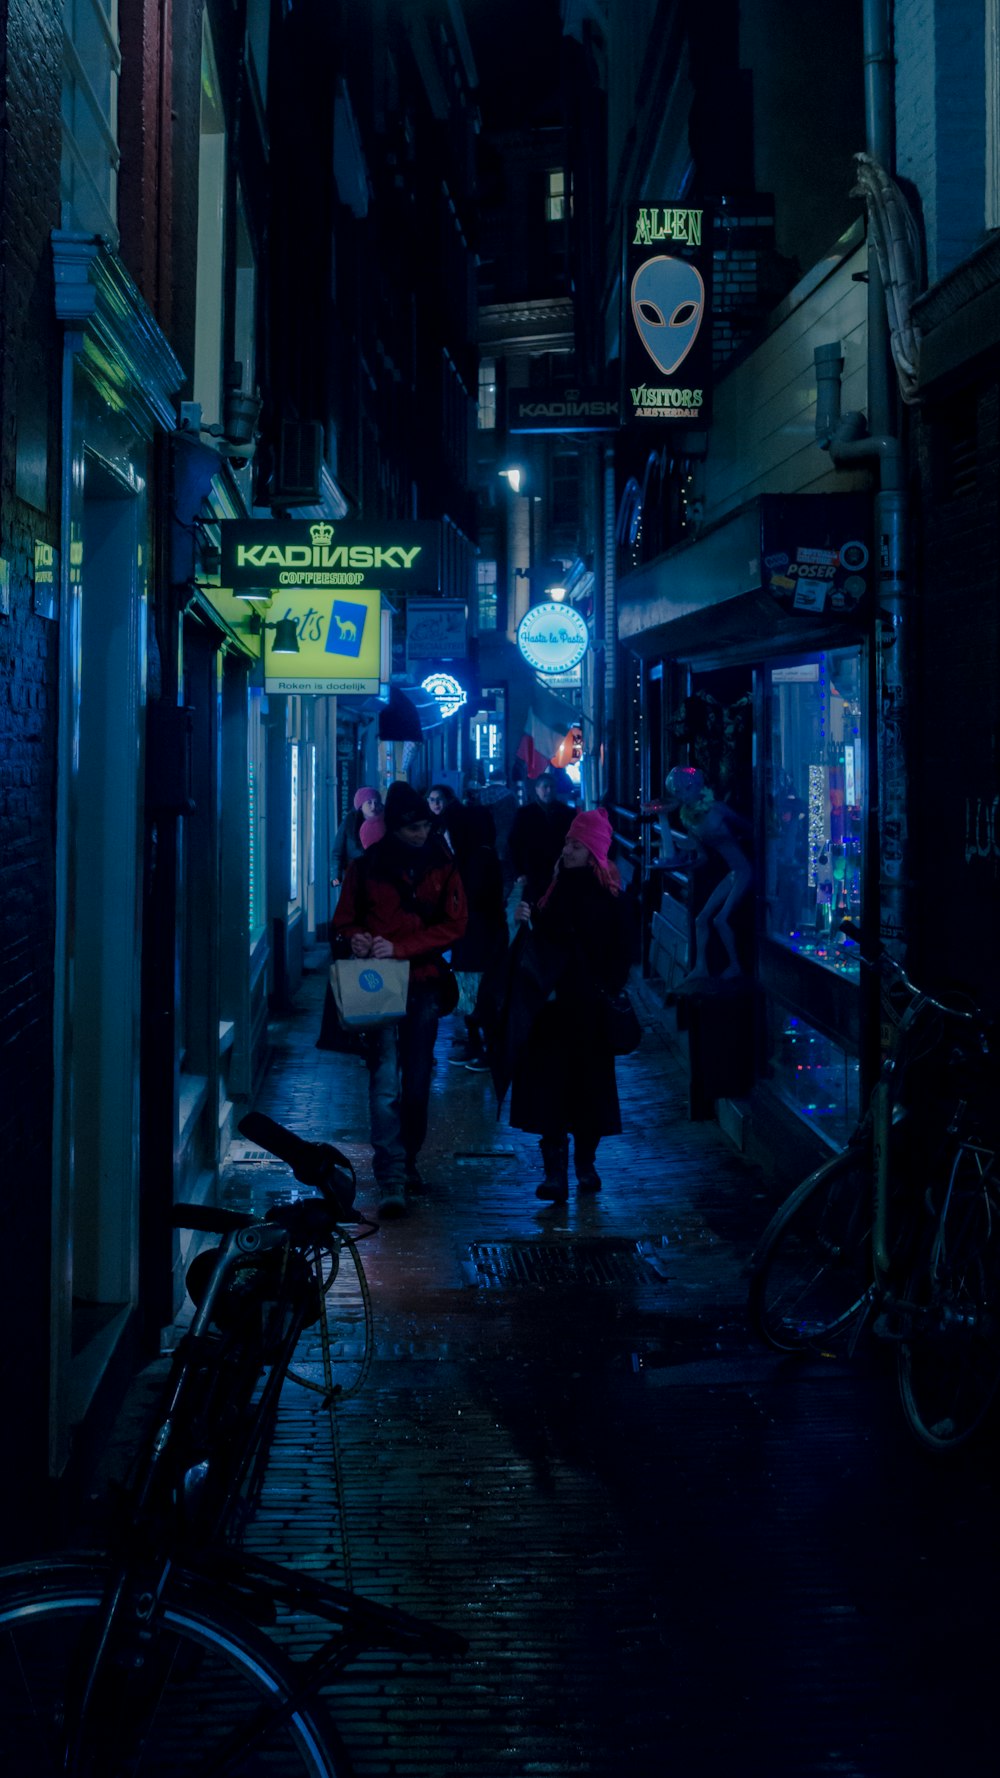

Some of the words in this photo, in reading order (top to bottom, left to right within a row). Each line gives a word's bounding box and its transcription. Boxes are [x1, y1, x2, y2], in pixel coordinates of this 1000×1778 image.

[632, 208, 704, 246] ALIEN
[630, 383, 704, 408] VISITORS
[519, 401, 619, 417] KADINSK
[635, 407, 699, 418] AMSTERDAM
[237, 545, 422, 568] KADINSKY
[279, 571, 364, 585] COFFEESHOP
[787, 564, 837, 578] POSER
[520, 632, 548, 643] Hasta
[549, 632, 558, 643] la
[559, 632, 585, 643] Pasta
[278, 682, 311, 690] Roken
[314, 682, 323, 690] is
[326, 682, 366, 691] dodelijk
